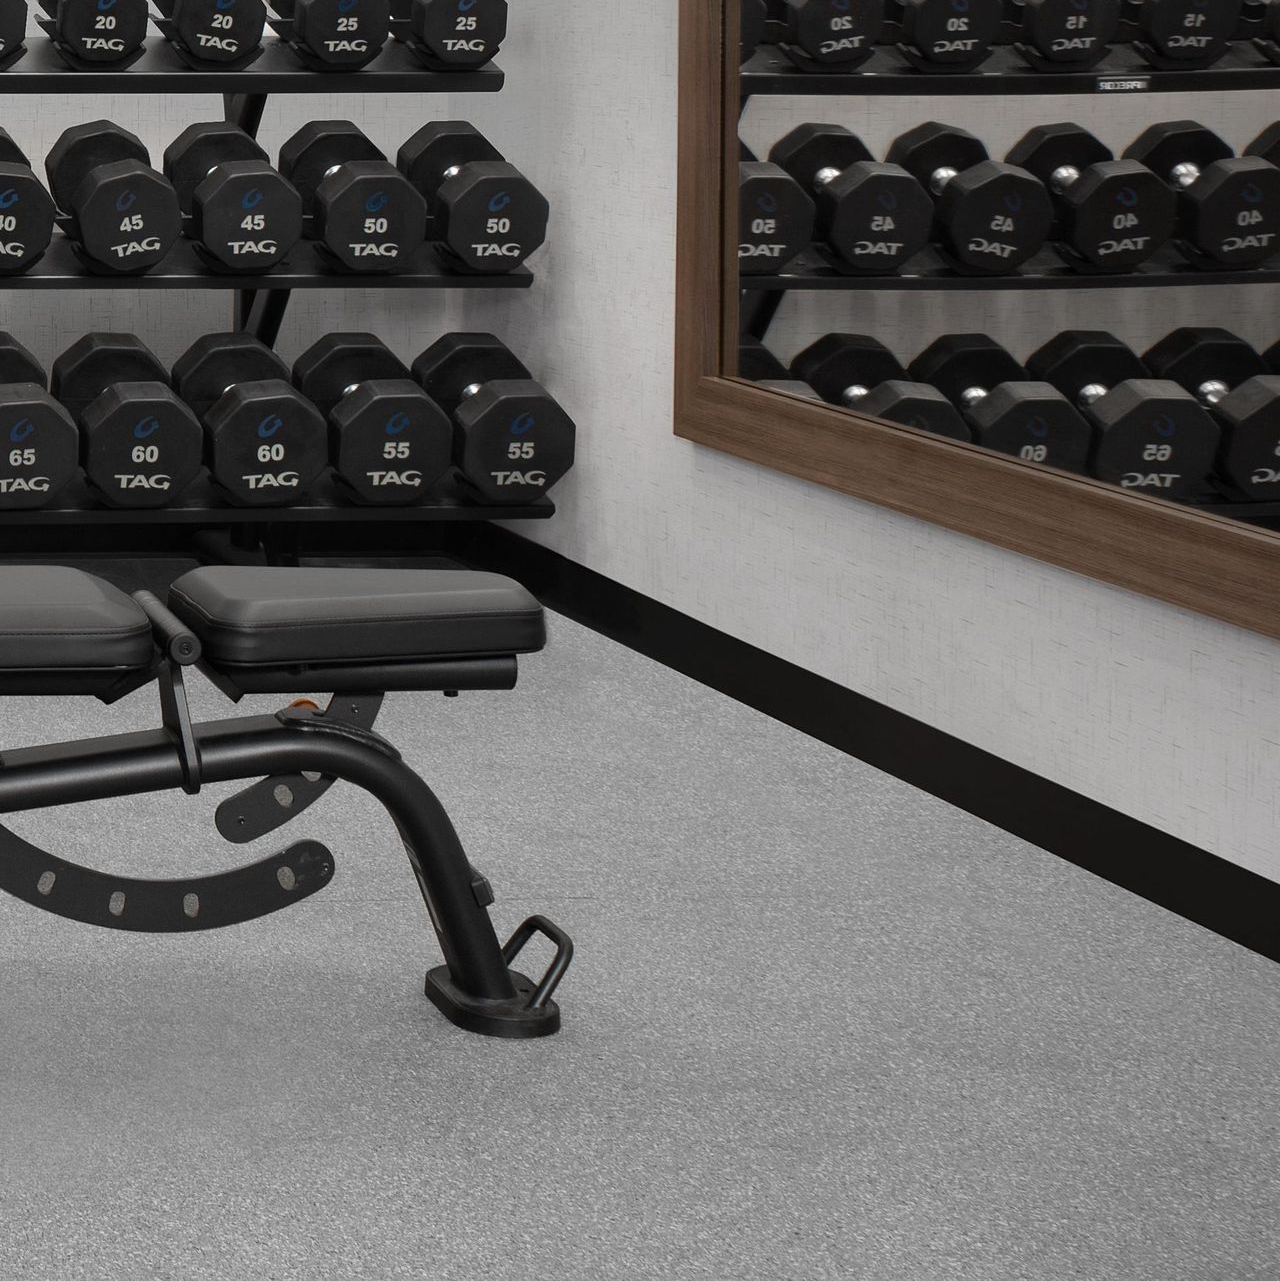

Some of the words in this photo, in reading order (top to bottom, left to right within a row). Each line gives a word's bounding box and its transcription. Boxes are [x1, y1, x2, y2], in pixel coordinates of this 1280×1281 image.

[94, 15, 117, 30] 20
[210, 13, 233, 30] 20
[336, 17, 358, 32] 25
[455, 16, 477, 31] 25
[81, 37, 125, 52] TAG
[196, 33, 239, 53] TAG
[323, 39, 367, 52] TAG
[442, 39, 485, 52] TAG
[119, 213, 144, 232] 45
[240, 214, 265, 231] 45
[363, 217, 388, 234] 50
[485, 217, 511, 234] 50
[110, 236, 161, 258] TAG
[227, 239, 277, 255] TAG
[348, 242, 399, 258] TAG
[471, 242, 521, 258] TAG
[8, 448, 36, 467] 65
[131, 445, 159, 463] 60
[257, 443, 285, 463] 60
[382, 441, 410, 460] 55
[507, 441, 535, 460] 55
[113, 474, 171, 490] TAG
[241, 471, 299, 489] TAG
[366, 470, 422, 487] TAG
[490, 470, 546, 487] TAG
